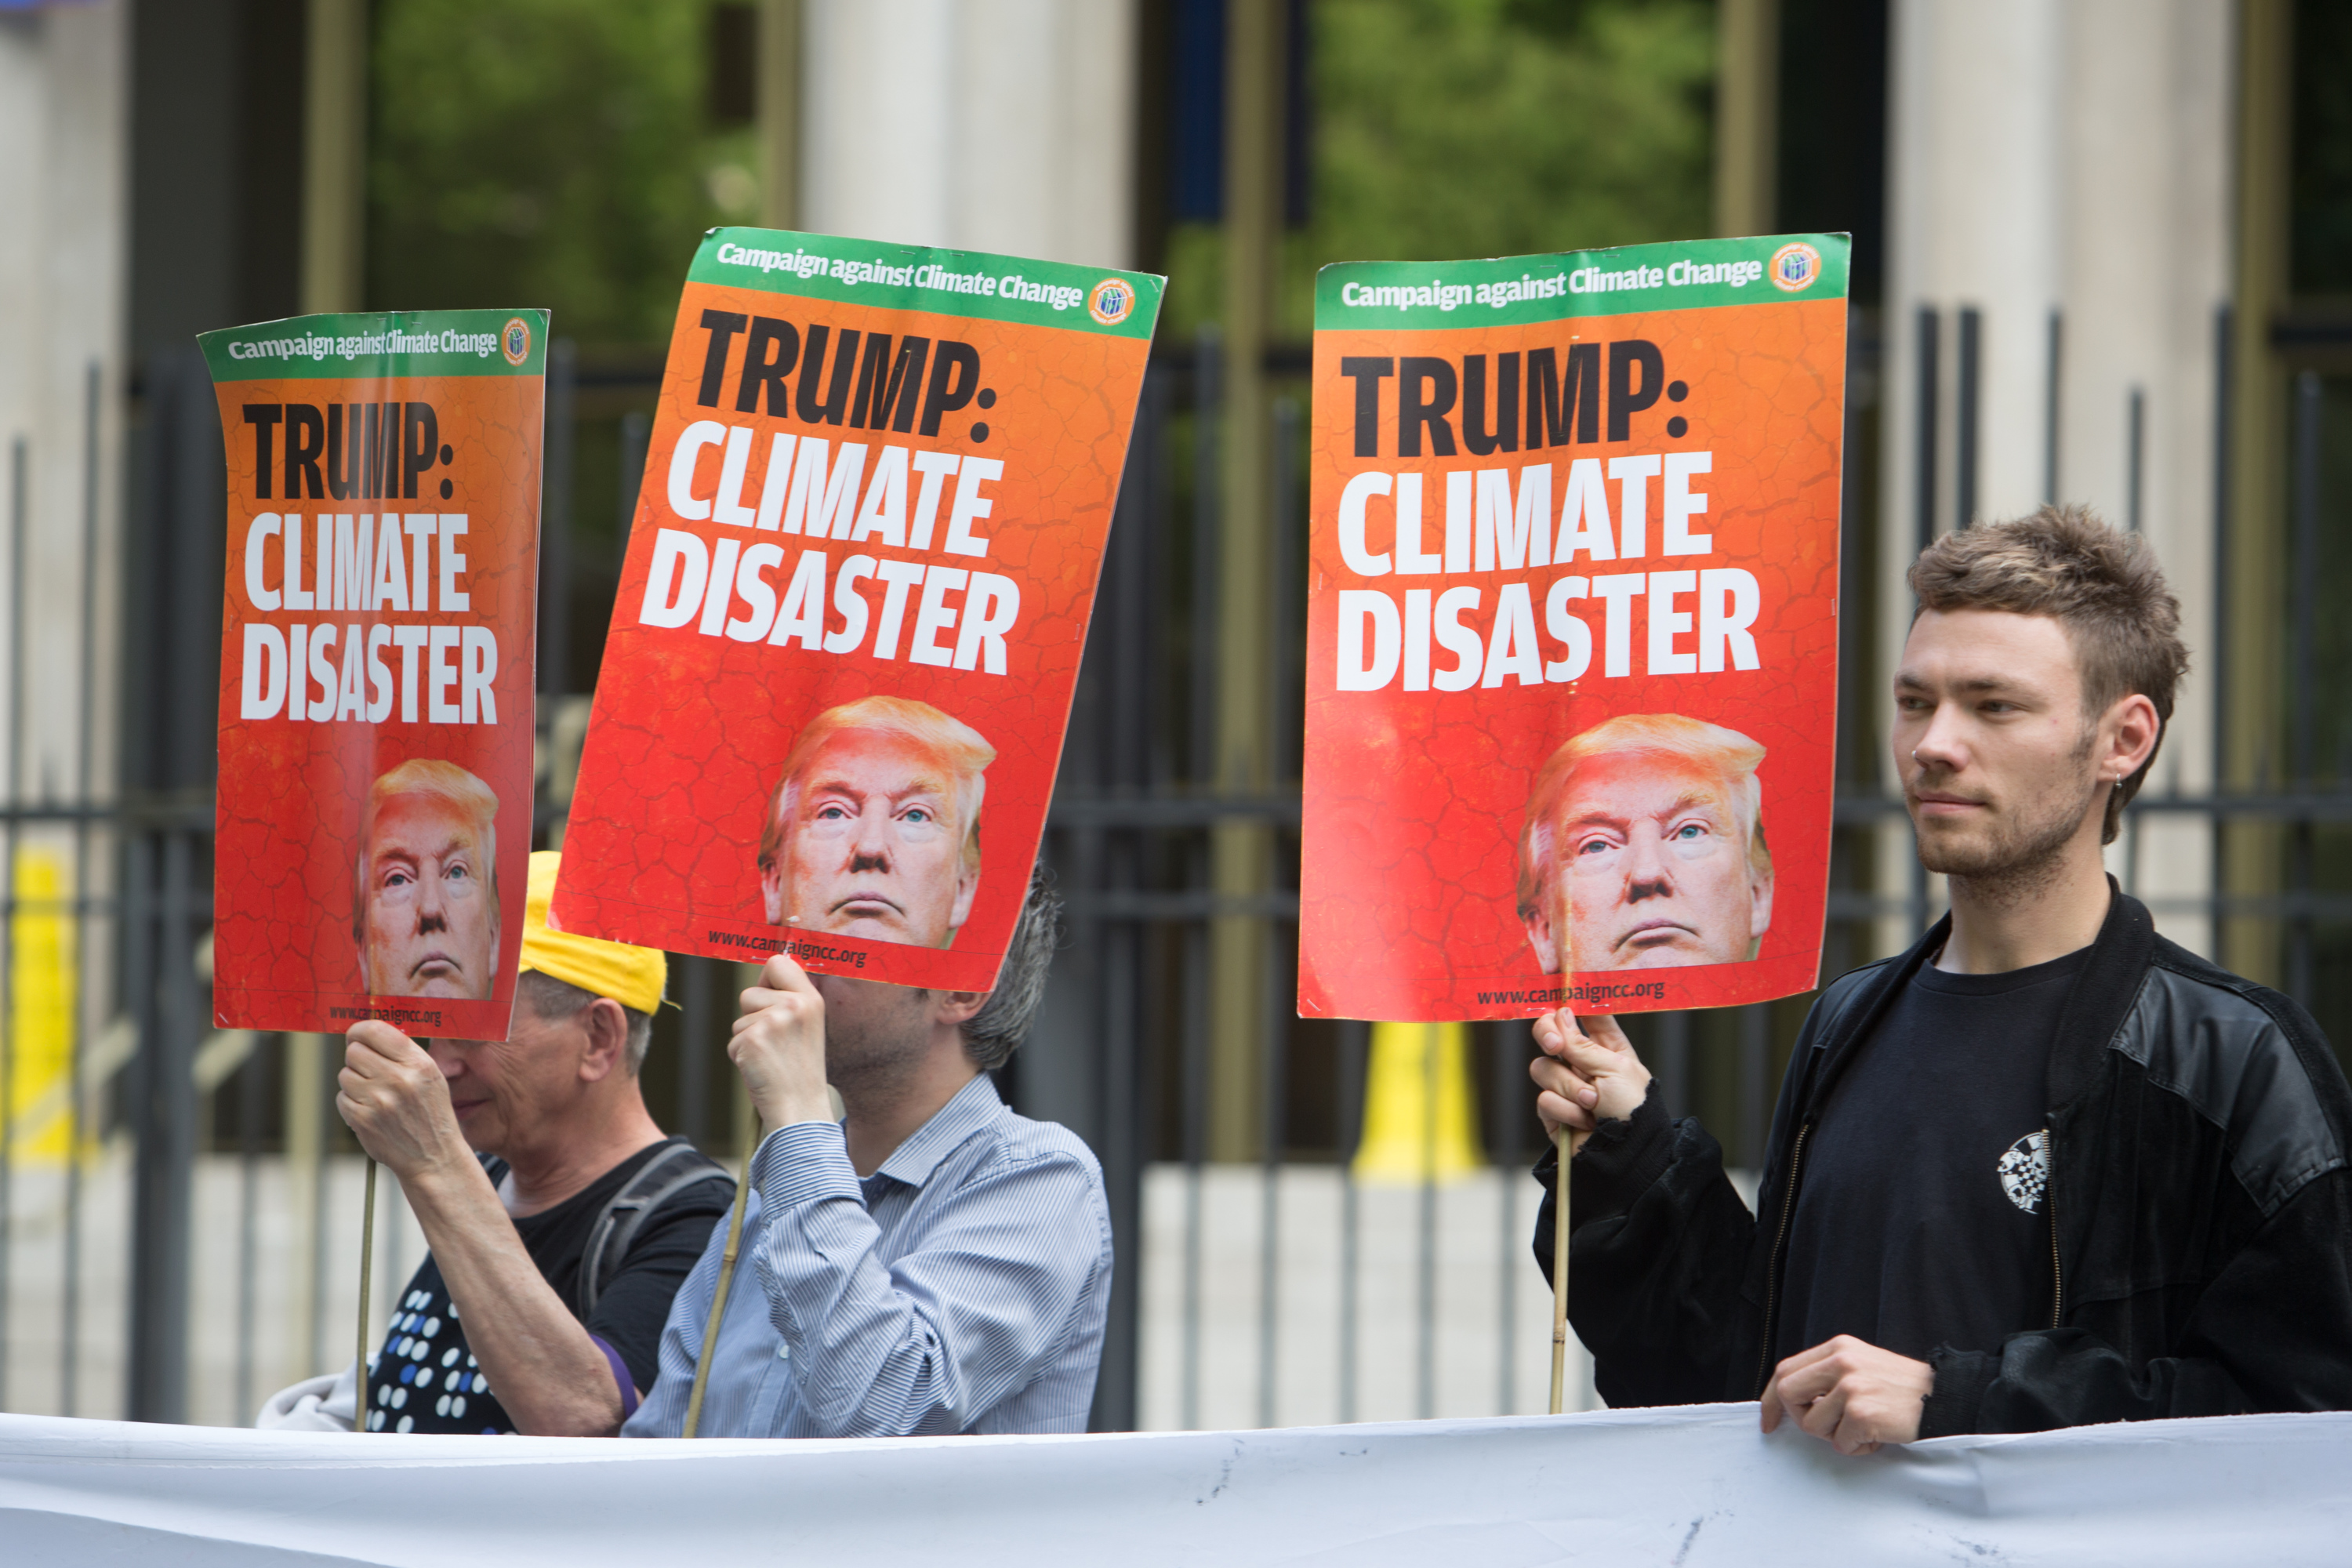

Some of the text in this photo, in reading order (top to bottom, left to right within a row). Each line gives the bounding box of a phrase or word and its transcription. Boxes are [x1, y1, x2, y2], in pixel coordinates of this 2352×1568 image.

[716, 242, 1083, 311] Campaign against Climate Change
[1341, 259, 1763, 311] Campaign against Climate Change
[228, 328, 497, 361] Campaign against Climate Change
[697, 308, 996, 444] TRUMP:
[1341, 339, 1689, 457] TRUMP:
[242, 401, 454, 501] TRUMP:
[667, 419, 1005, 557] CLIMATE
[245, 512, 470, 612] CLIMATE
[1338, 451, 1712, 576] CLIMATE
[638, 527, 1020, 676] DISASTER
[1336, 568, 1761, 691] DISASTER
[240, 622, 498, 725] DISASTER
[1477, 982, 1665, 1005] www.campaigncc.org
